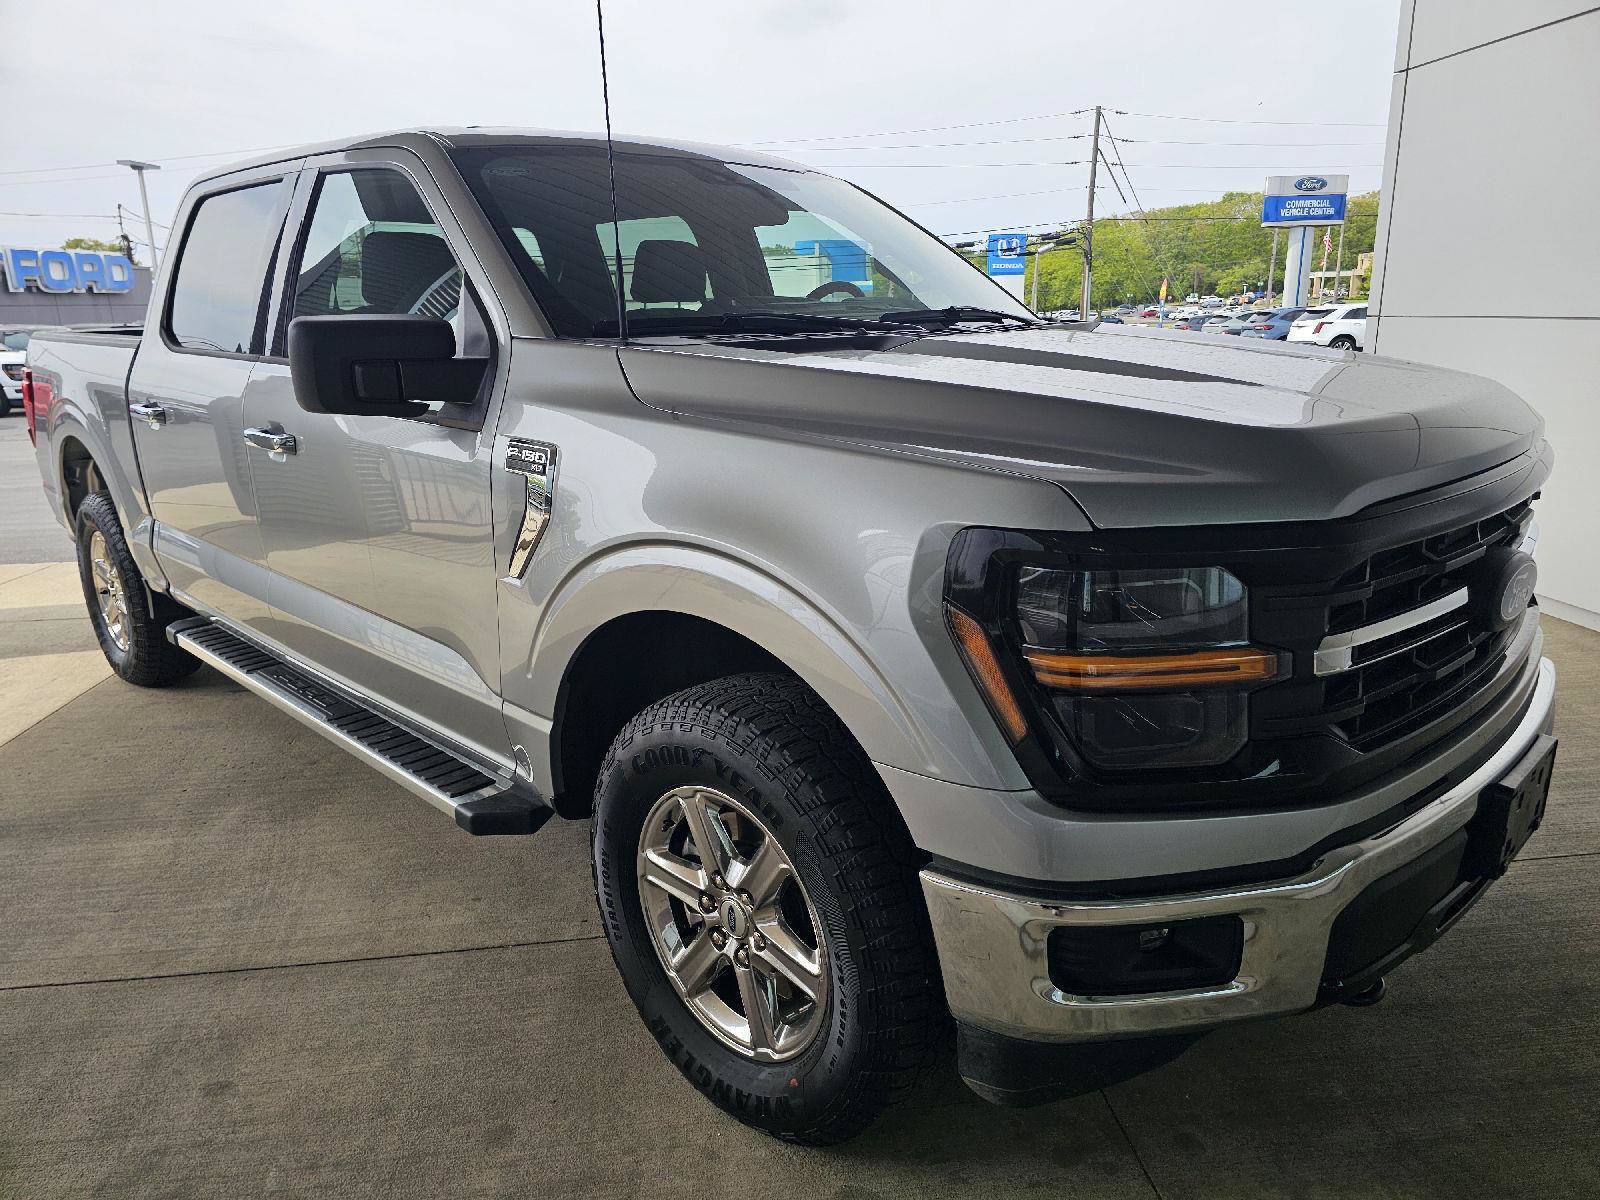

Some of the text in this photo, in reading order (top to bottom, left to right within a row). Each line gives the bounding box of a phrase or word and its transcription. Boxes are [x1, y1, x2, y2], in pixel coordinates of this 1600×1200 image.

[1280, 207, 1334, 216] VEHICLE CENTER
[1286, 199, 1331, 208] COMMERCIAL
[7, 248, 134, 293] FORD
[507, 446, 547, 463] F-150
[601, 848, 623, 942] TERRITORY
